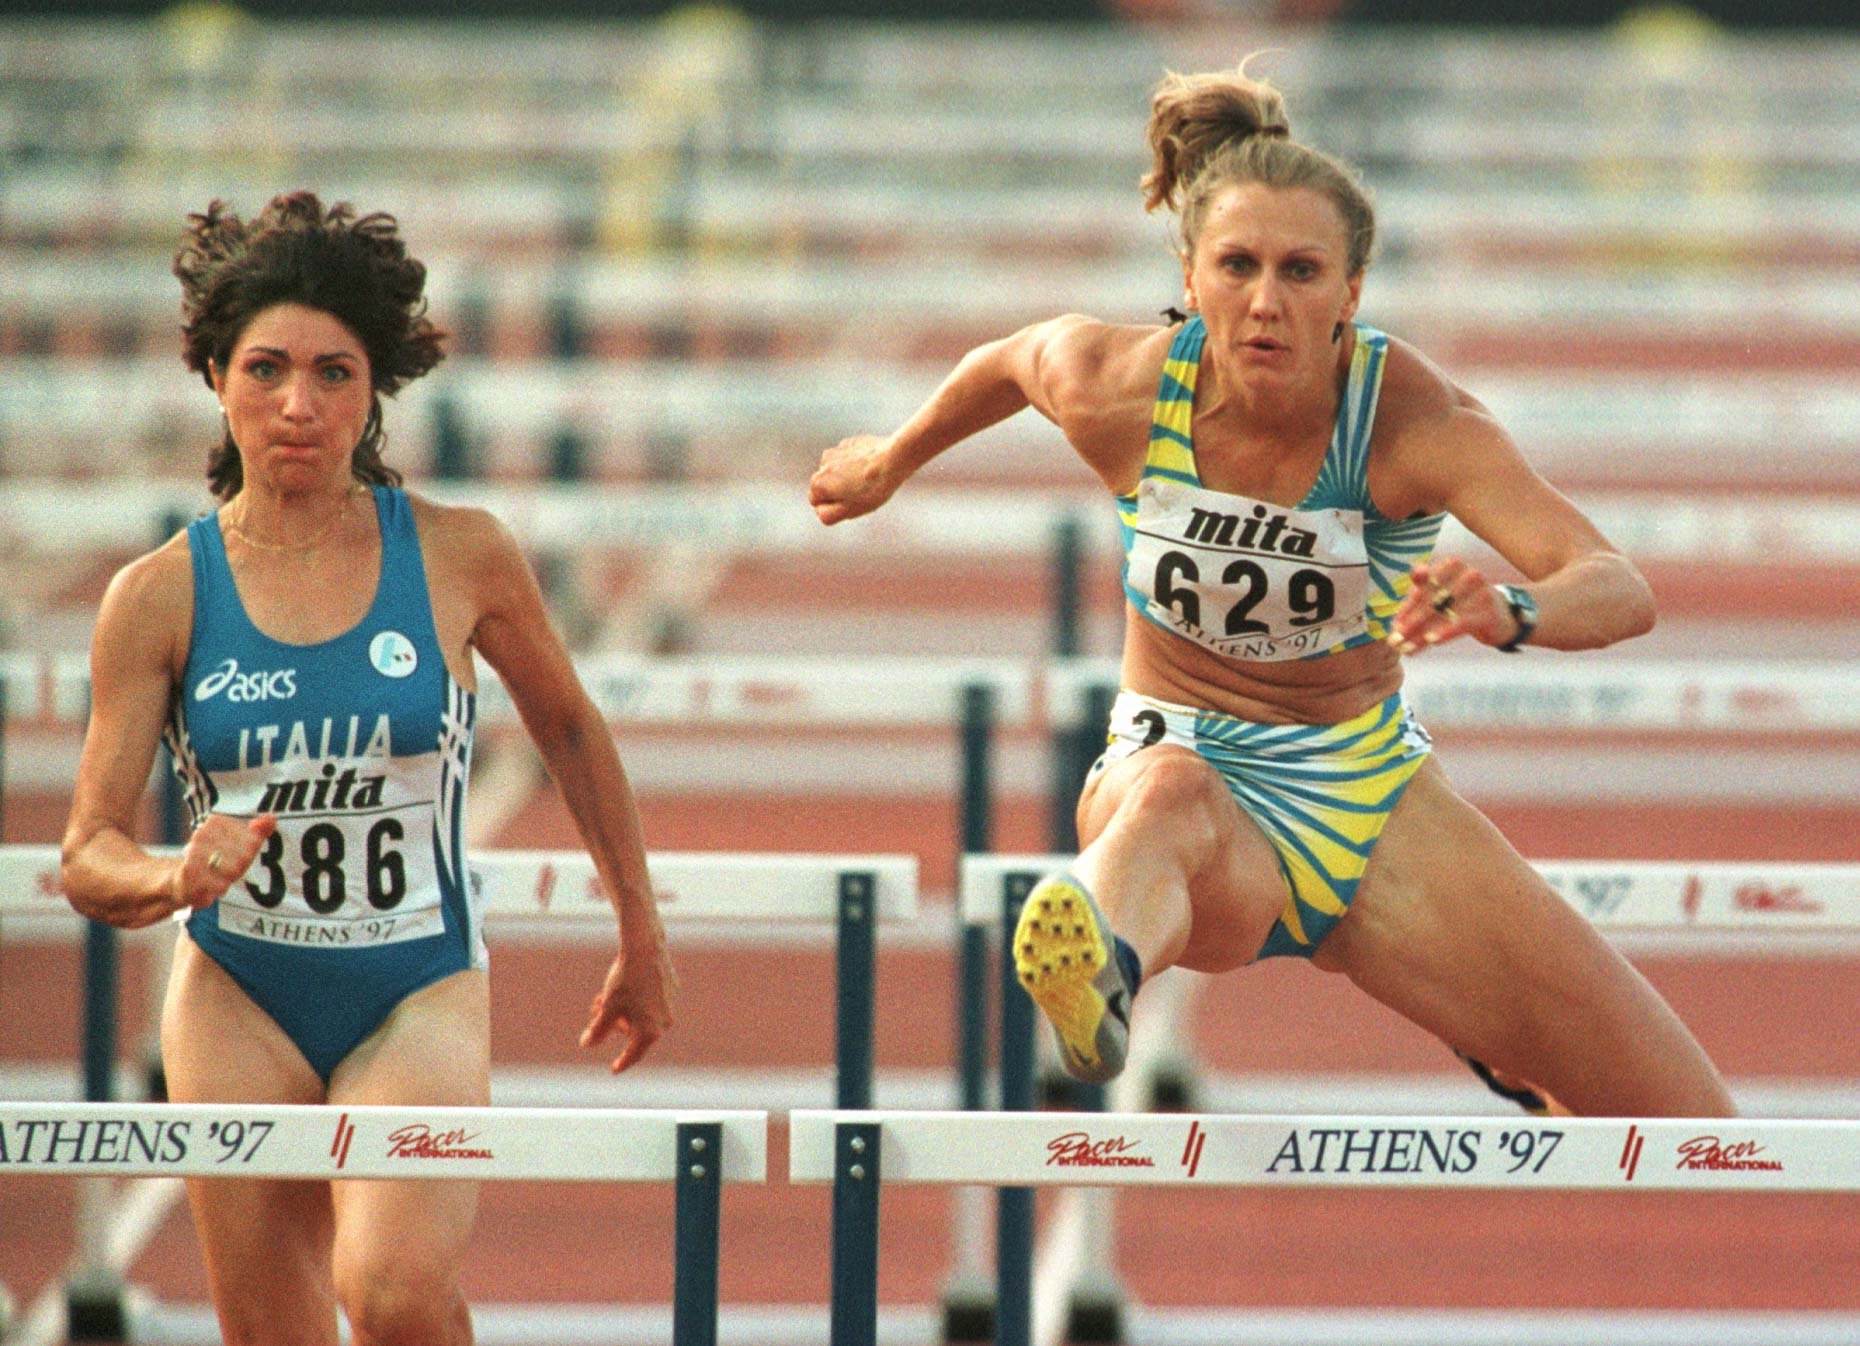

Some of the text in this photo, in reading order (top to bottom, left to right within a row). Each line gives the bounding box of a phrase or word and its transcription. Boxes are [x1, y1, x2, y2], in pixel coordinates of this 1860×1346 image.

[1184, 505, 1318, 559] mita
[1154, 551, 1335, 637] 629
[228, 668, 297, 702] asics
[257, 763, 387, 813] mita
[245, 817, 407, 914] 386
[250, 917, 350, 944] ATHENS
[0, 1119, 275, 1164] THENS '97
[1265, 1128, 1565, 1174] ATHENS '97
